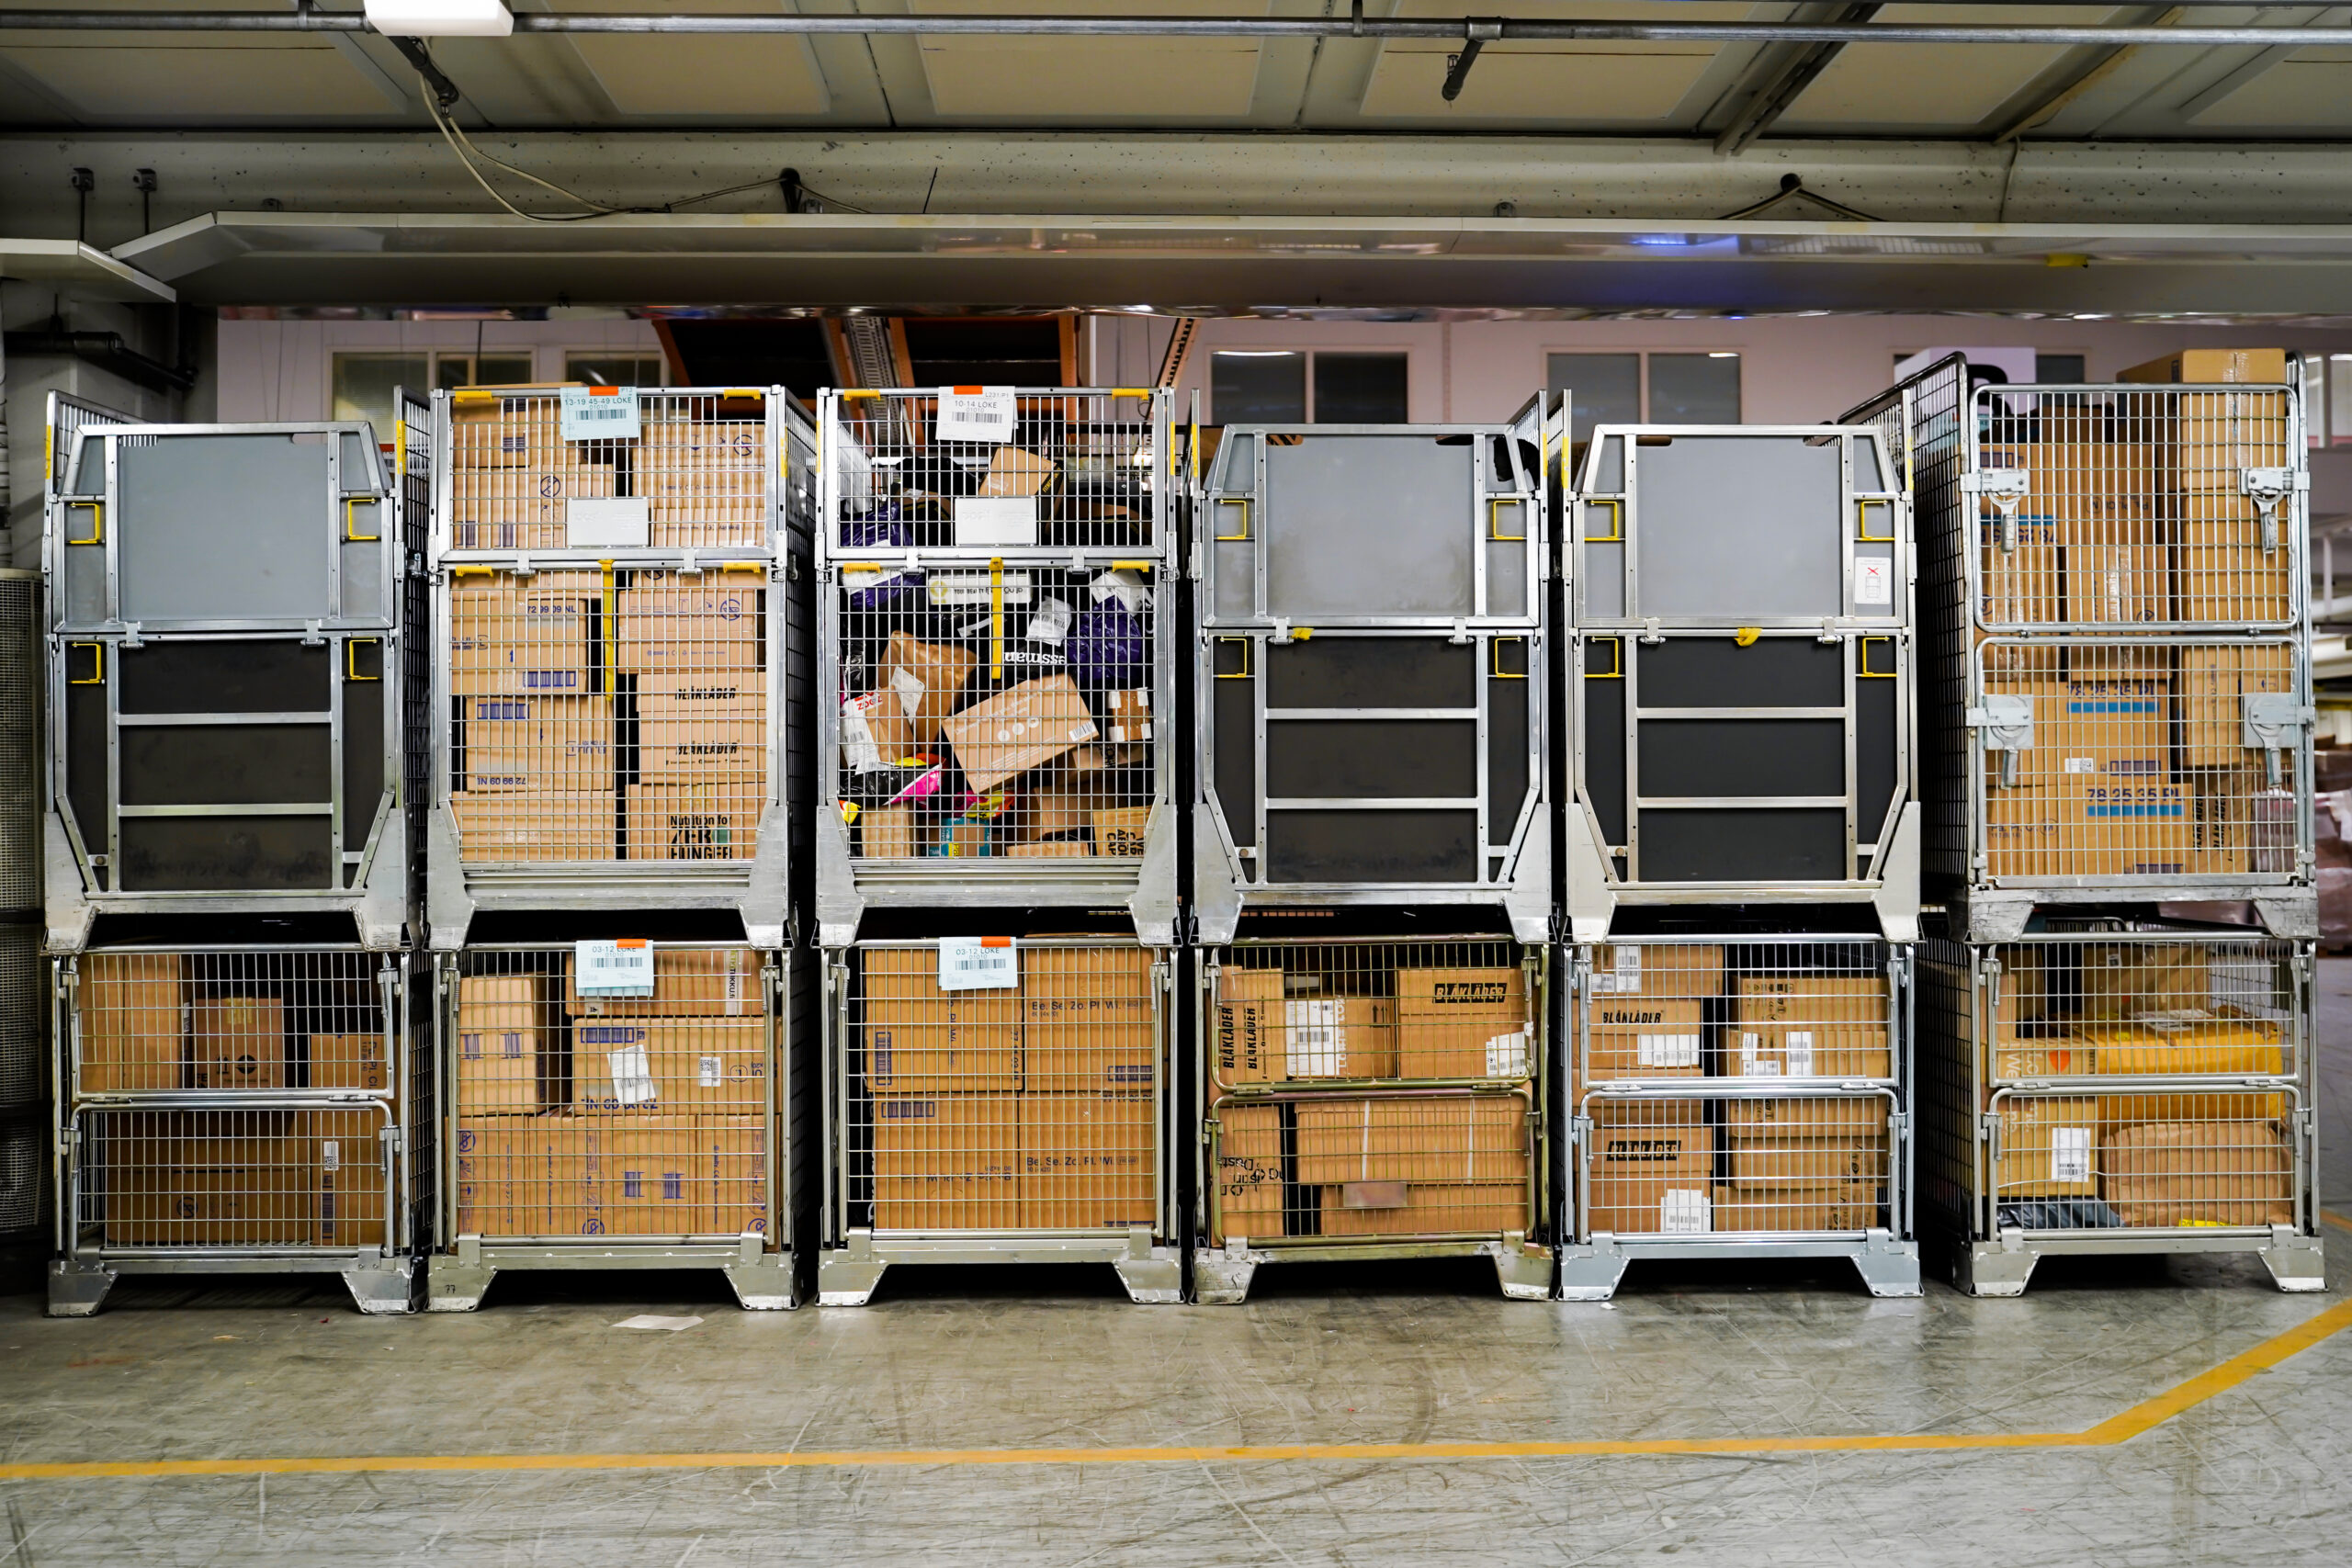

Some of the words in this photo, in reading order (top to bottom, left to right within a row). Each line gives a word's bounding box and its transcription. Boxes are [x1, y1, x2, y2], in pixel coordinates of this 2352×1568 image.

[490, 777, 501, 785] 09
[514, 777, 526, 785] 72
[2086, 788, 2108, 803] 78
[2111, 788, 2132, 803] 25
[2136, 788, 2157, 803] 35
[2162, 788, 2185, 803] PL
[1436, 985, 1505, 1000] BLÅKLÄDER
[1602, 1010, 1662, 1023] BLÅKLÄDER
[1221, 1007, 1235, 1068] BLÅKLÄDER
[1611, 1142, 1678, 1158] BLÅKLÄDER
[1046, 1156, 1062, 1166] Se.
